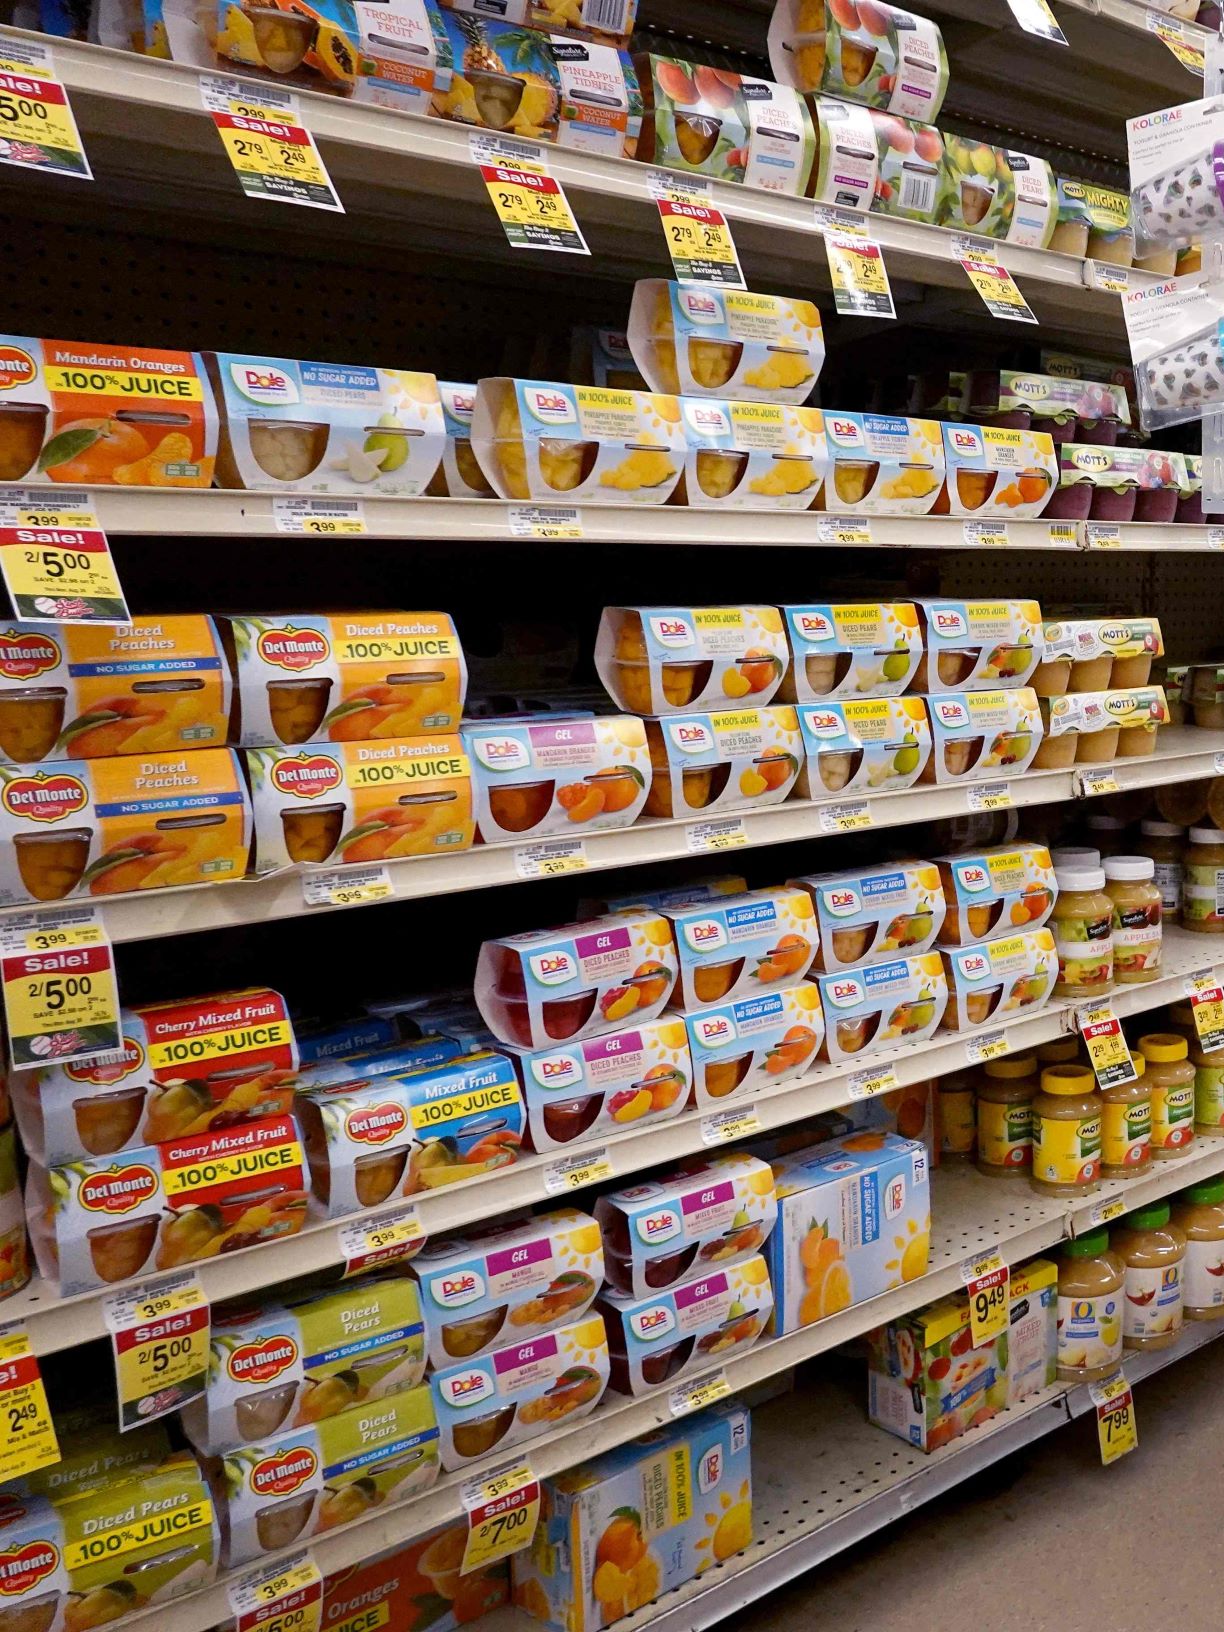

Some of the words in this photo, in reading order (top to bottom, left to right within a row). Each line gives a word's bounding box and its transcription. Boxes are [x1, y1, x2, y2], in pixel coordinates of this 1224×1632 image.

[363, 8, 423, 31] TROPICAL
[377, 21, 414, 38] FRUIT
[383, 62, 427, 79] COCONUT
[383, 71, 414, 85] WATER
[562, 65, 622, 84] PINEAPPLE
[0, 76, 42, 95] ale!
[573, 76, 615, 92] TIDBITS
[761, 106, 789, 120] DICED
[1132, 109, 1183, 132] KOLORAE
[232, 116, 291, 137] Sale!
[496, 169, 543, 187] Sale!
[671, 203, 711, 219] Sale!
[1087, 190, 1128, 214] MIGHTY
[1127, 282, 1178, 303] KOLORAE
[687, 294, 715, 310] Dole
[55, 351, 126, 368] Mandarin
[130, 356, 186, 374] Oranges
[60, 371, 119, 390] 100%
[120, 376, 193, 396] JUICE
[245, 370, 286, 388] Dole
[303, 372, 316, 381] NO
[318, 372, 346, 384] SUGAR
[348, 375, 377, 386] ADDED
[536, 393, 567, 409] Dole
[578, 392, 586, 402] IN
[610, 394, 633, 406] JUICE
[834, 421, 857, 435] Dole
[955, 433, 976, 447] Dole
[16, 530, 84, 545] Sale!
[116, 625, 163, 638] Diced
[345, 623, 384, 636] Diced
[387, 623, 439, 634] Peaches
[660, 622, 687, 633] Dole
[802, 618, 826, 629] Dole
[9, 646, 54, 660] Monte
[109, 637, 175, 651] Peaches
[347, 642, 392, 658] 100%
[393, 640, 450, 656] JUICE
[96, 665, 113, 673] NO
[118, 663, 155, 672] SUGAR
[158, 661, 196, 669] ADDED
[814, 715, 837, 727] Dole
[555, 730, 572, 740] GEL
[679, 728, 704, 741] Dole
[358, 747, 396, 760] Diced
[400, 743, 450, 756] Peaches
[141, 761, 187, 775] Diced
[358, 764, 404, 783] 100%
[405, 759, 463, 778] JUICE
[135, 774, 199, 789] Peaches
[9, 791, 33, 805] Del
[35, 787, 81, 802] Monte
[121, 804, 138, 812] NO
[142, 801, 179, 810] SUGAR
[183, 797, 219, 806] ADDED
[694, 925, 718, 938] Dole
[25, 952, 89, 972] Sale!
[540, 957, 567, 972] Dole
[1197, 991, 1217, 1002] Sale!
[155, 1018, 195, 1034] Cherry
[199, 1008, 242, 1026] Mixed
[245, 1004, 276, 1019] Fruit
[703, 1020, 727, 1035] Dole
[1091, 1024, 1112, 1036] Sale!
[164, 1039, 216, 1062] 100%
[217, 1026, 282, 1051] JUICE
[542, 1059, 573, 1075] Dole
[425, 1082, 467, 1099] Mixed
[470, 1072, 498, 1088] Fruit
[422, 1102, 462, 1122] 100%
[462, 1087, 513, 1111] JUICE
[169, 1143, 209, 1160] Cherry
[212, 1132, 254, 1151] Mixed
[257, 1126, 287, 1142] Fruit
[177, 1163, 229, 1187] 100%
[230, 1148, 294, 1175] JUICE
[893, 1184, 902, 1209] Dole
[646, 1214, 672, 1230] Dole
[511, 1249, 529, 1263] GEL
[442, 1274, 475, 1294] Dole
[340, 1301, 380, 1323] Diced
[640, 1310, 666, 1328] Dole
[134, 1315, 192, 1342] Sale!
[343, 1316, 381, 1335] Pears
[324, 1351, 338, 1361] NO
[341, 1340, 372, 1358] SUGAR
[374, 1331, 405, 1346] ADDED
[451, 1374, 483, 1393] Dole
[1104, 1397, 1125, 1414] Sale!
[358, 1409, 396, 1432] Diced
[361, 1423, 397, 1443] Pears
[343, 1461, 356, 1470] NO
[358, 1448, 389, 1465] SUGAR
[391, 1436, 420, 1452] ADDED
[483, 1491, 526, 1517] Sale!
[82, 1507, 135, 1534] Diced
[141, 1493, 189, 1516] Pears
[80, 1531, 133, 1560] 100%
[135, 1507, 203, 1542] JUICE
[255, 1592, 306, 1622] Sale!
[327, 1577, 401, 1619] Oranges
